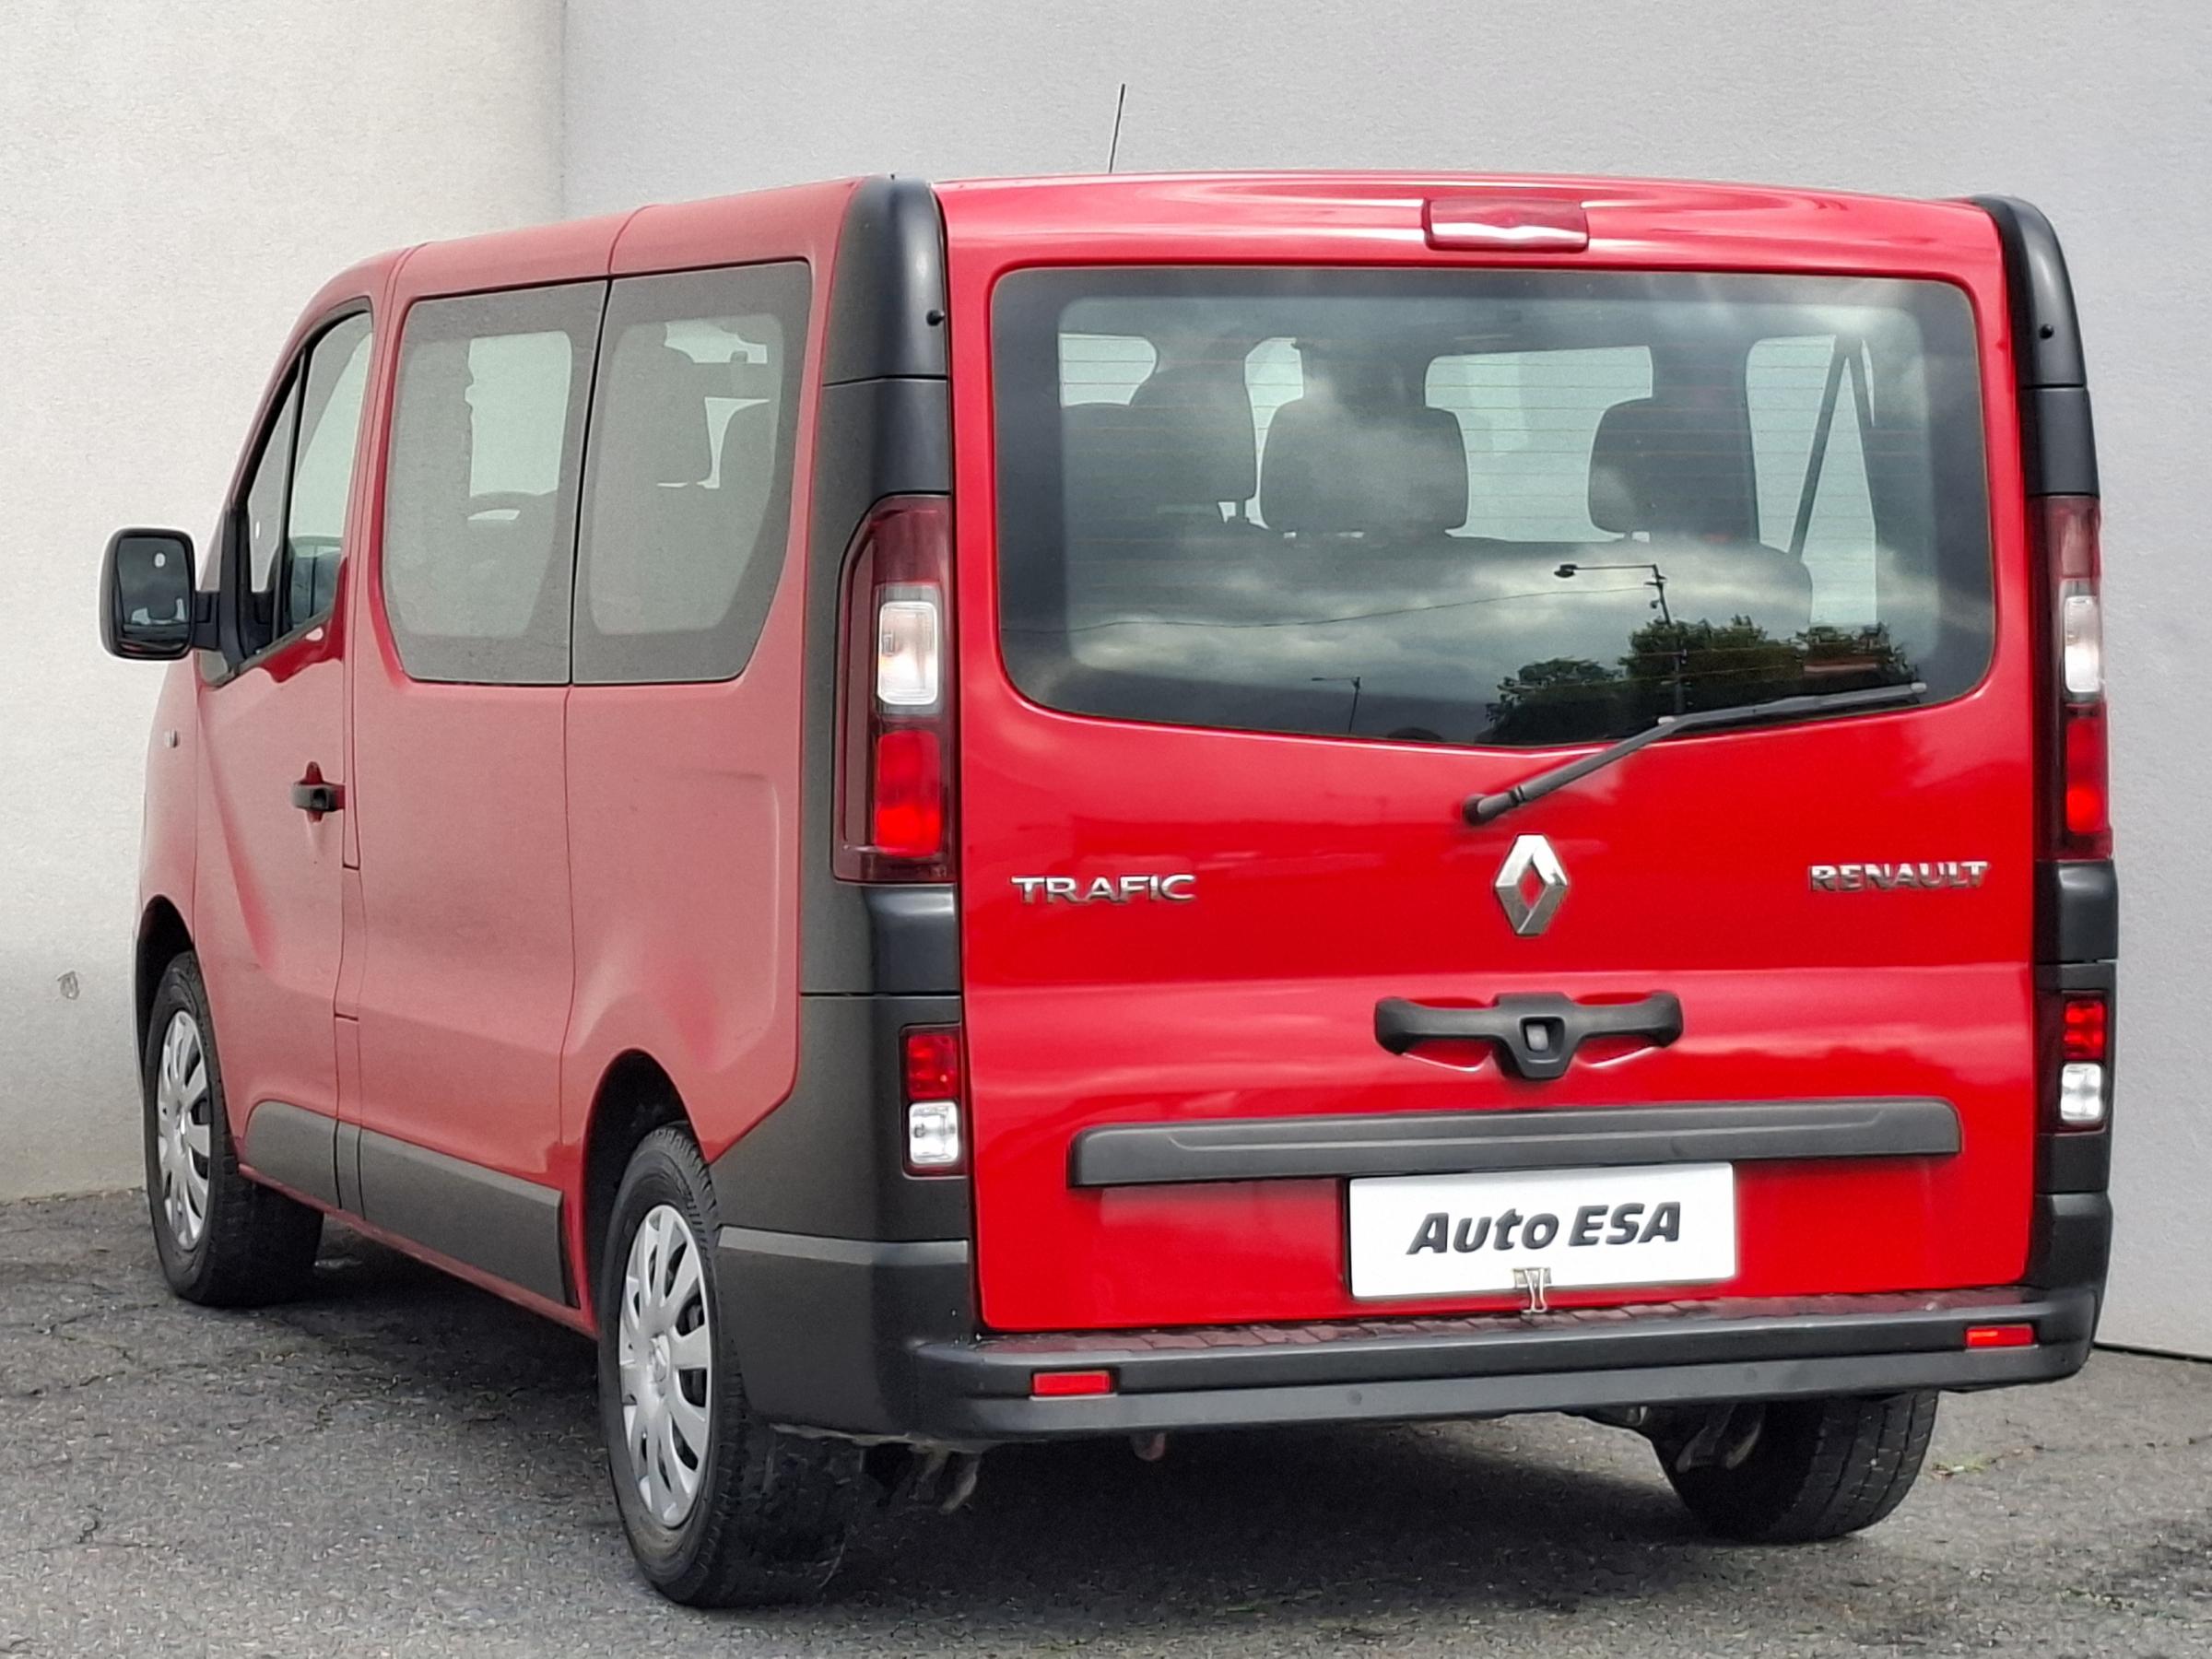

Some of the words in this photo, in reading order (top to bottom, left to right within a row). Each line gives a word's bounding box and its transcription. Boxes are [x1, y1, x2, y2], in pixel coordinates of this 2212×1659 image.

[1011, 875, 1196, 903] TRAFIC
[1809, 860, 1988, 890] RENAULT
[1406, 1208, 1559, 1254] Auto
[1569, 1202, 1681, 1246] ESA
